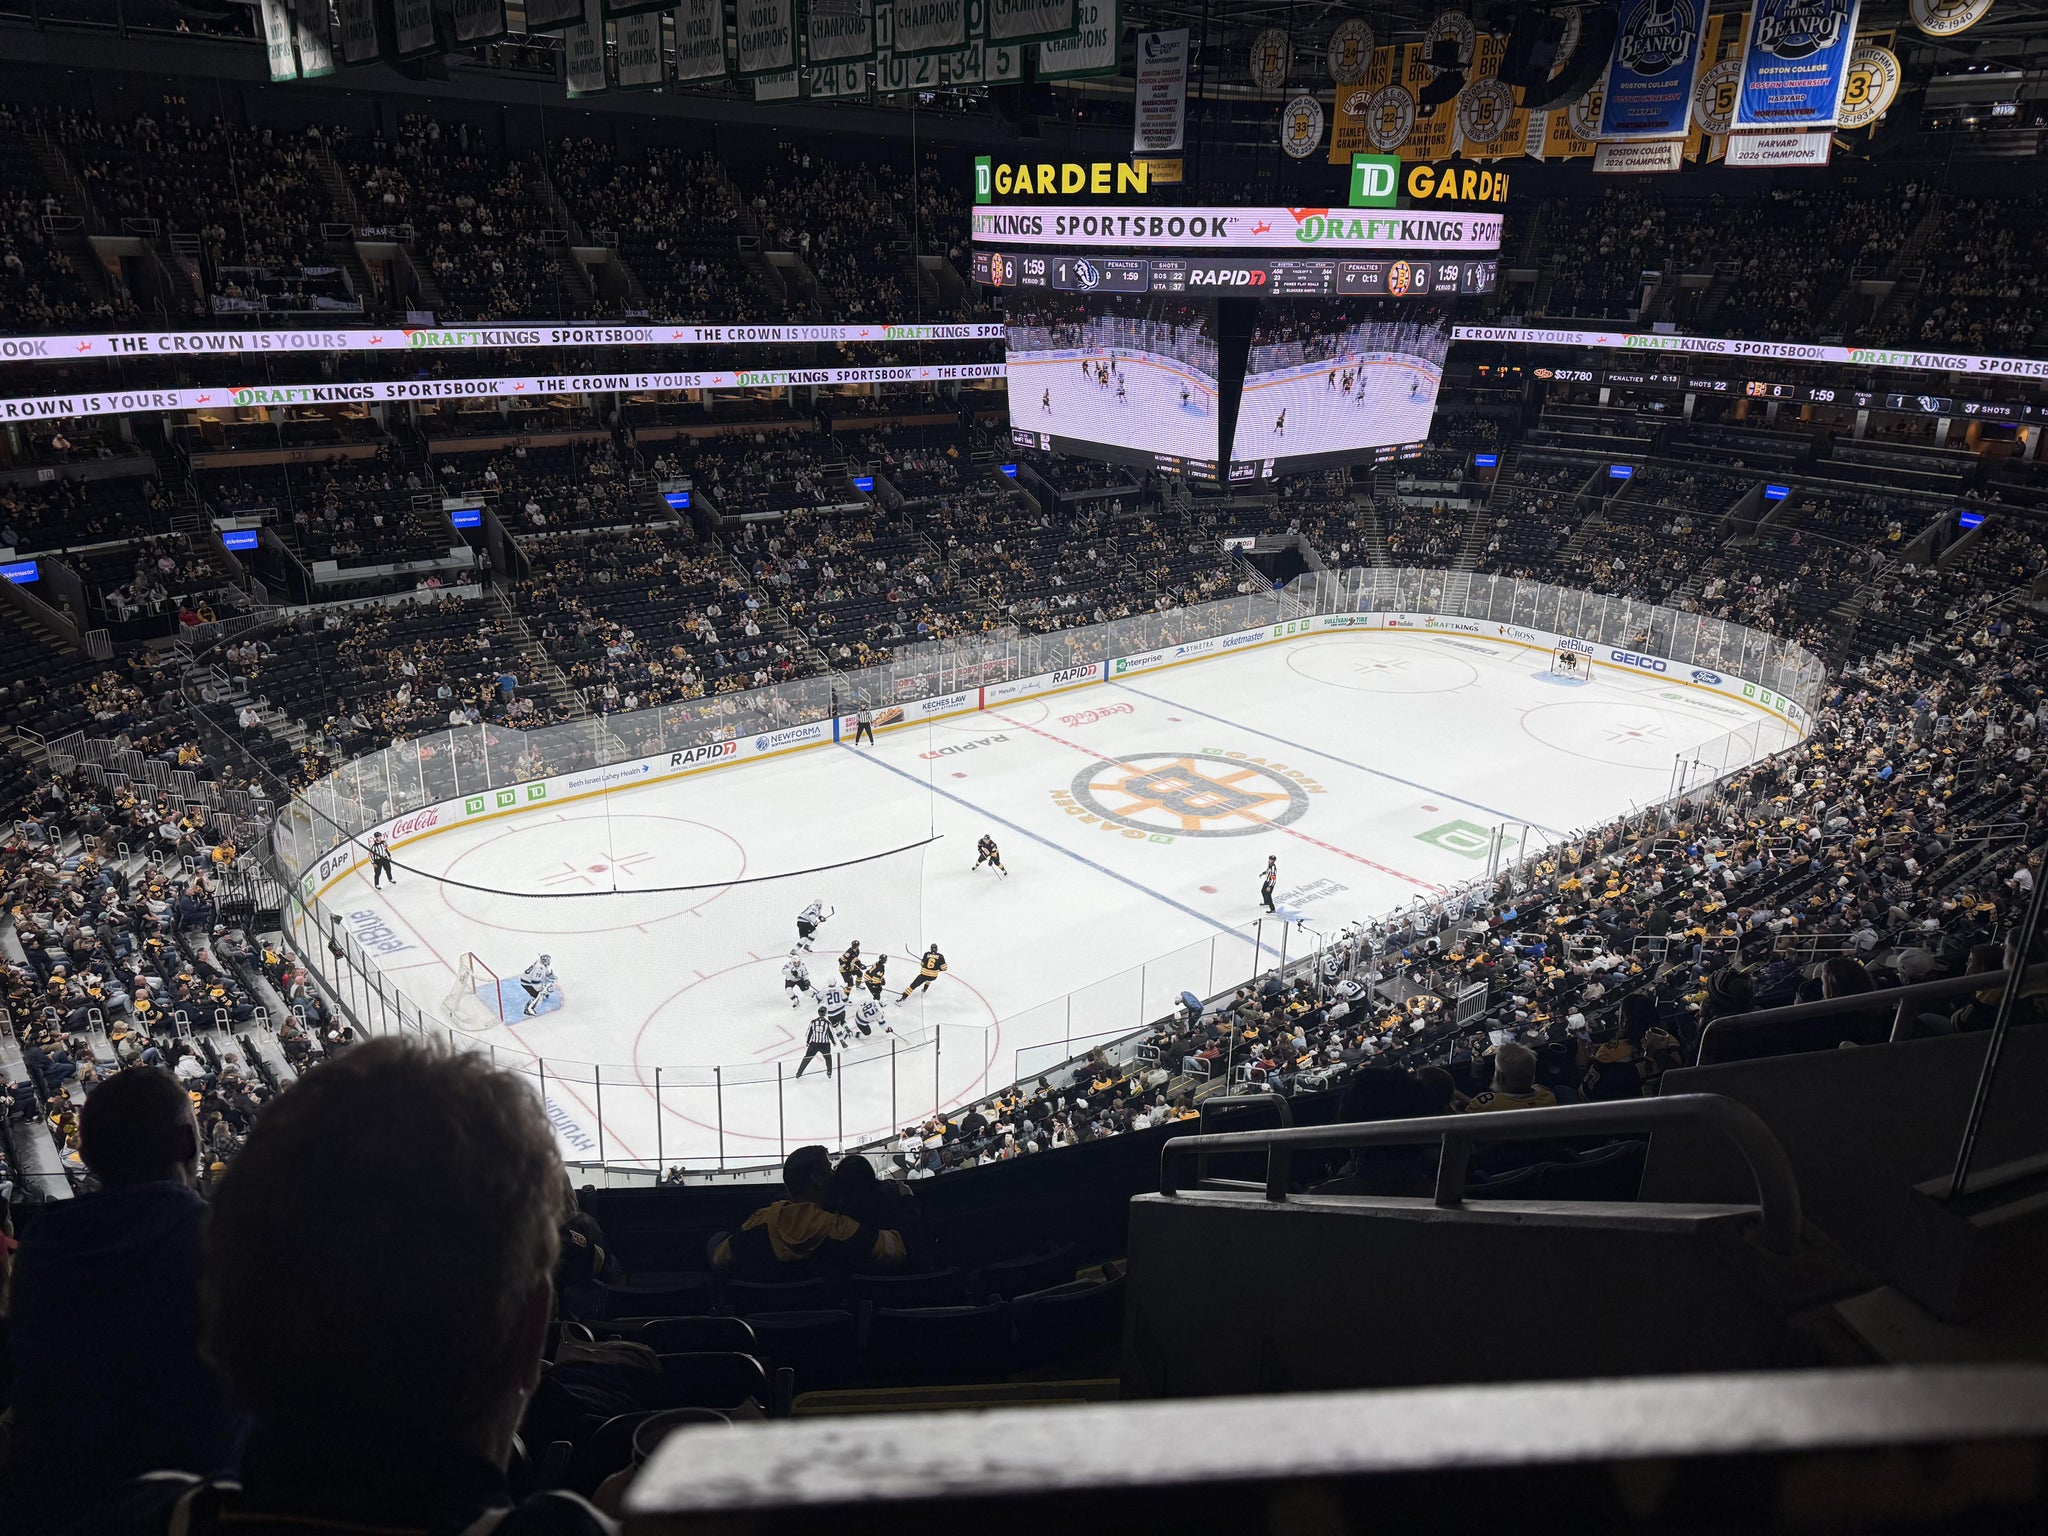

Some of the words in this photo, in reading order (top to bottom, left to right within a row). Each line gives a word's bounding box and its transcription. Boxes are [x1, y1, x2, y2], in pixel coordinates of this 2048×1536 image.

[751, 6, 777, 28] WORLD
[899, 0, 960, 28] CHAMPIONS
[1783, 8, 1824, 17] WOMEN'S
[1923, 12, 1973, 30] 1926-1940
[813, 16, 866, 39] CHAMPIONS
[1643, 26, 1671, 36] MEN'S
[1755, 11, 1850, 47] BEANPOT
[742, 27, 789, 51] CHAMPIONS
[1617, 31, 1697, 63] BEANPOT
[878, 53, 903, 88] 10
[916, 56, 929, 84] 2
[952, 43, 980, 80] 34
[996, 47, 1009, 75] 5
[1759, 67, 1791, 75] BOSTON
[1791, 64, 1828, 74] COLLEGE
[1858, 50, 1895, 82] HITCHMAN
[811, 66, 836, 95] 24
[846, 64, 858, 90] 6
[1648, 80, 1679, 88] COLLEGE
[1695, 66, 1718, 103] AUBREY
[1750, 81, 1781, 90] BOSTON
[1783, 78, 1831, 89] UNIVERSITY
[1849, 77, 1866, 98] 3
[1719, 88, 1731, 109] 5
[1768, 95, 1807, 103] HARVARD
[1383, 113, 1395, 123] 22
[1480, 102, 1494, 121] 15
[1628, 108, 1662, 116] HARVARD
[1754, 109, 1816, 117] NORTHEASTERN
[1295, 122, 1307, 132] 33
[1608, 148, 1639, 157] BOSTON
[1640, 147, 1671, 156] COLLEGE
[1757, 139, 1799, 149] HARVARD
[1605, 159, 1623, 167] 2026
[1625, 158, 1671, 166] CHAMPIONS
[1738, 152, 1760, 160] 2026
[1762, 150, 1816, 160] CHAMPIONS
[995, 163, 1149, 195] GARDEN
[1357, 163, 1395, 196] TD
[1408, 165, 1509, 203] GARDEN
[1056, 215, 1228, 238] SPORTSBOOK
[1296, 216, 1464, 242] DRAFTKINGS
[1006, 261, 1013, 279] 6
[1023, 259, 1045, 276] 1:59
[1059, 264, 1066, 282] 1
[1105, 272, 1111, 280] 9
[1122, 272, 1139, 281] 1:59
[1190, 270, 1267, 286] RAPID7
[1346, 275, 1356, 283] 47
[1415, 269, 1425, 287] 6
[1439, 265, 1459, 281] 1:59
[1468, 269, 1473, 286] 1
[1173, 283, 1183, 291] 37
[109, 337, 149, 352] THE
[159, 335, 244, 352] CROWN
[252, 335, 272, 349] IS
[276, 334, 348, 349] YOURS
[409, 331, 541, 349] DRAFTKINGS
[552, 330, 653, 343] SPORTSBOOK
[695, 328, 722, 340] THE
[728, 328, 782, 340] CROWN
[786, 328, 799, 339] IS
[802, 327, 846, 339] YOURS
[885, 327, 970, 341] DRAFTKINGS
[1466, 329, 1517, 340] CROWN
[1522, 330, 1534, 341] IS
[1537, 331, 1583, 344] YOURS
[1626, 335, 1725, 352] DRAFTKINGS
[1734, 343, 1825, 360] SPORTSBOOK
[1848, 350, 1968, 370] DRAFTKINGS
[83, 397, 101, 412] IS
[107, 393, 179, 410] YOURS
[233, 386, 375, 406] DRAFTKINGS
[386, 381, 500, 397] SPORTSBOOK
[537, 378, 566, 392] THE
[573, 376, 630, 391] CROWN
[636, 376, 649, 388] IS
[653, 375, 701, 387] YOURS
[737, 372, 829, 387] DRAFTKINGS
[837, 369, 913, 382] SPORTSBOOK
[937, 367, 957, 378] THE
[961, 366, 1000, 377] CROWN
[1555, 370, 1593, 382] $37,780
[1609, 374, 1644, 383] PENALTIES
[1663, 374, 1677, 382] 0:13
[1690, 380, 1712, 388] SHOTS
[1714, 381, 1727, 390] 22
[1773, 386, 1782, 396] 6
[1809, 389, 1835, 402] 1:59
[1859, 397, 1866, 406] 3
[1896, 397, 1903, 408] 1
[1964, 403, 1980, 414] 37
[1981, 406, 2012, 416] SHOTS
[1425, 621, 1479, 632] DRAFTKINGS
[1507, 626, 1536, 641] CROSS
[1186, 640, 1214, 653] SYMETRA
[1223, 631, 1265, 648] ticketmaster
[1119, 654, 1162, 671] enterprise
[1610, 650, 1667, 673] GEICO
[1052, 664, 1098, 684] RAPID7
[922, 698, 950, 710] KECHES
[950, 694, 967, 704] LAW
[771, 726, 820, 743] NEWFORMA
[671, 741, 737, 767] RAPID7
[568, 779, 583, 789] Beth
[585, 777, 602, 787] Israel
[602, 772, 619, 784] Lahey
[620, 768, 640, 779] Health
[1226, 750, 1329, 796] GARDEN
[392, 806, 440, 839] Coca-Cola
[1050, 788, 1147, 842] GARDEN
[331, 852, 349, 872] APP
[826, 991, 840, 1005] 20
[862, 1002, 876, 1019] 82
